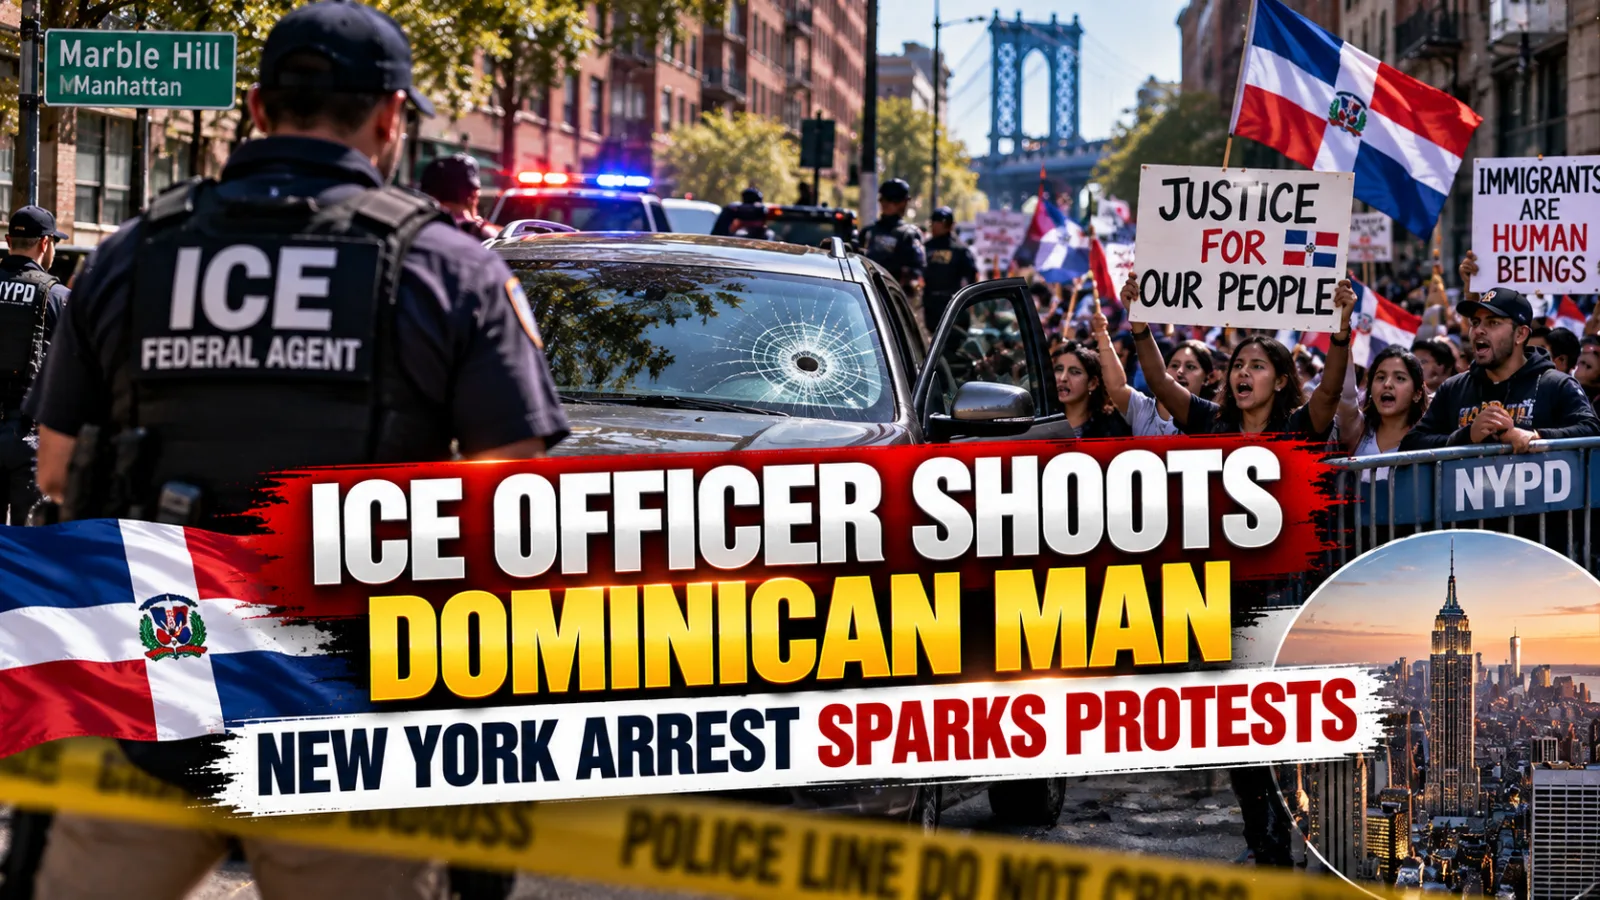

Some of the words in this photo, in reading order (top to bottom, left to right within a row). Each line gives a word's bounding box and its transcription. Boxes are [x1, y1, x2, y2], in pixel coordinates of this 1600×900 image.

[59, 39, 160, 69] Marble
[173, 42, 220, 70] Hill
[1478, 164, 1600, 195] IMMIGRANTS
[1158, 176, 1320, 224] JUSTICE
[1519, 197, 1560, 220] ARE
[1200, 228, 1267, 265] FOR
[1492, 223, 1588, 253] HUMAN
[169, 244, 339, 331] ICE
[1497, 255, 1586, 284] BEINGS
[1139, 268, 1203, 310] OUR
[1218, 271, 1336, 316] PEOPLE
[141, 336, 260, 370] FEDERAL
[266, 336, 362, 371] AGENT
[1455, 459, 1572, 512] NYPD
[620, 807, 784, 884] POLICE
[801, 829, 905, 899] LINE
[918, 843, 984, 900] DO
[997, 853, 1091, 900] NOT
